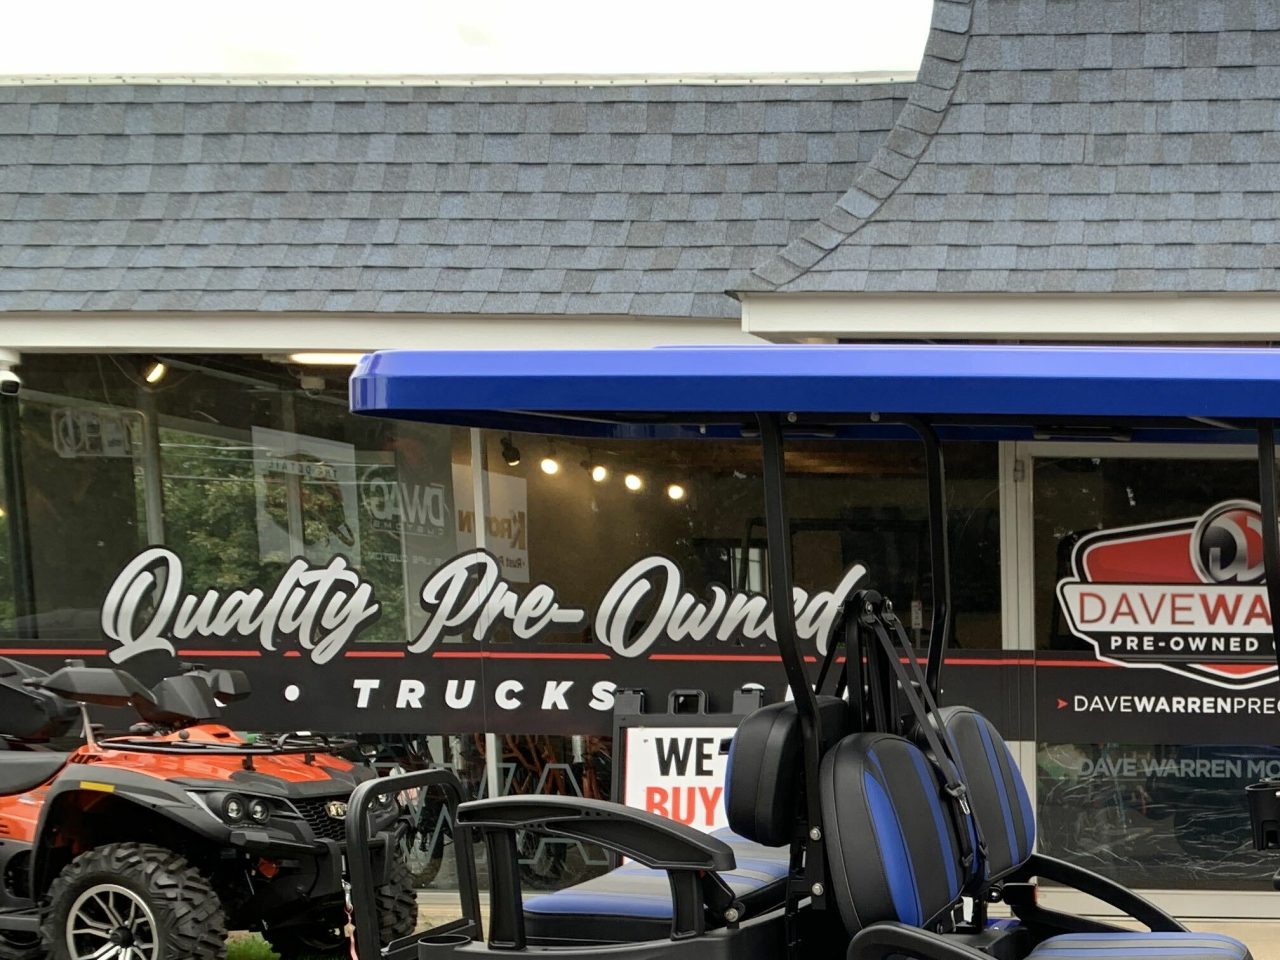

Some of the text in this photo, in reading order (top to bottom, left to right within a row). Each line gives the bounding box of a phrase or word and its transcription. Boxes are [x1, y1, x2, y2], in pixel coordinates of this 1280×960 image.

[102, 546, 380, 665] Quality
[1109, 635, 1260, 653] PRE-OWNED
[353, 678, 618, 711] TRUCKS
[655, 737, 714, 777] WE
[1078, 757, 1138, 778] DAVE
[1141, 758, 1242, 779] WARREN
[646, 786, 724, 827] BUY
